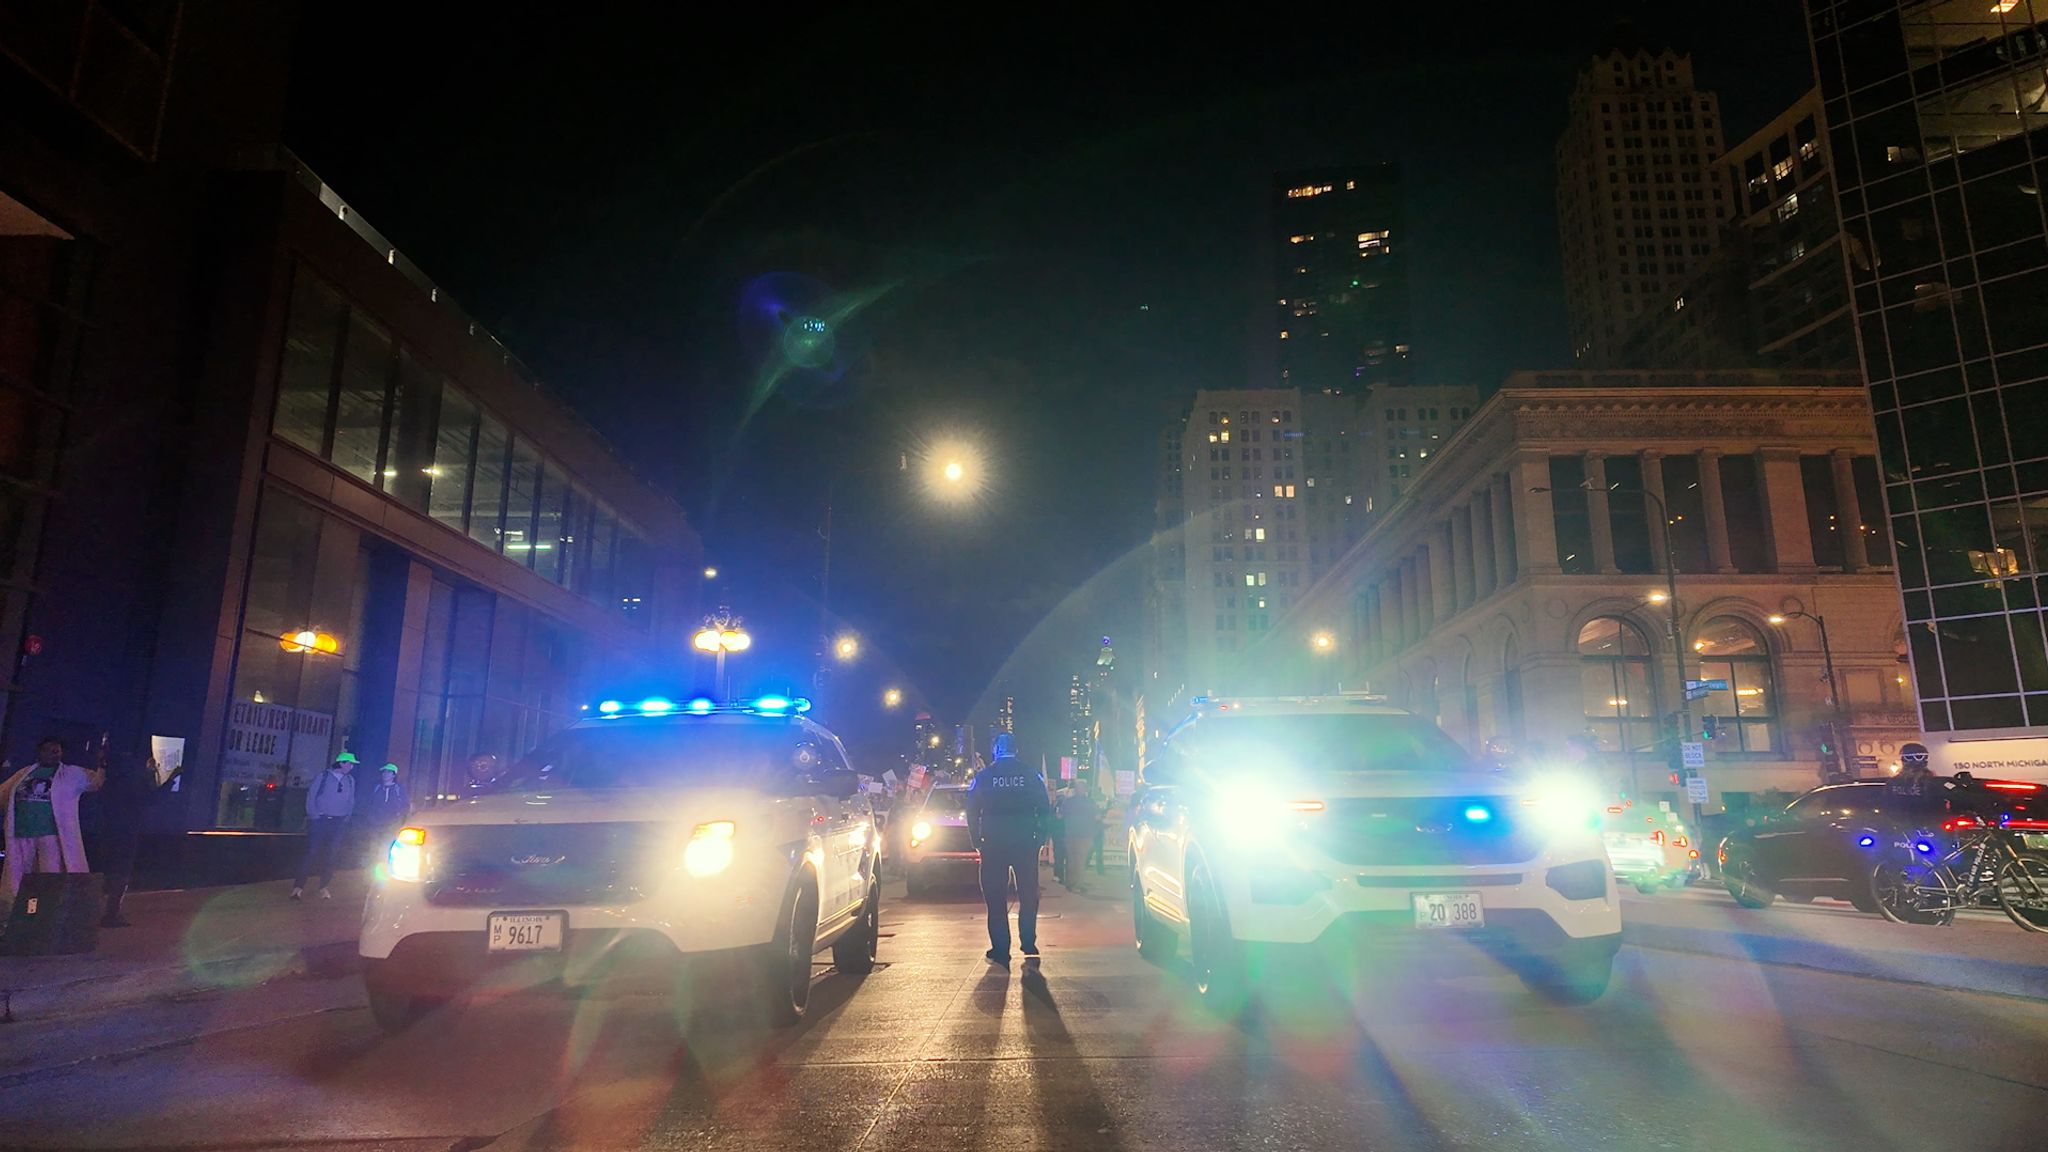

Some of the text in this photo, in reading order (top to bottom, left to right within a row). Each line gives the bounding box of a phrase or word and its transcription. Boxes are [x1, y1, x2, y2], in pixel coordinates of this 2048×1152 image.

[234, 703, 330, 735] ETAIL/RESTAURANT
[229, 729, 277, 755] OR LEASE
[1972, 761, 2004, 769] NORTH
[2006, 760, 2048, 768] MICHIGA
[992, 776, 1025, 787] POLICE
[1429, 902, 1477, 921] 20 388
[508, 925, 543, 945] 9617
